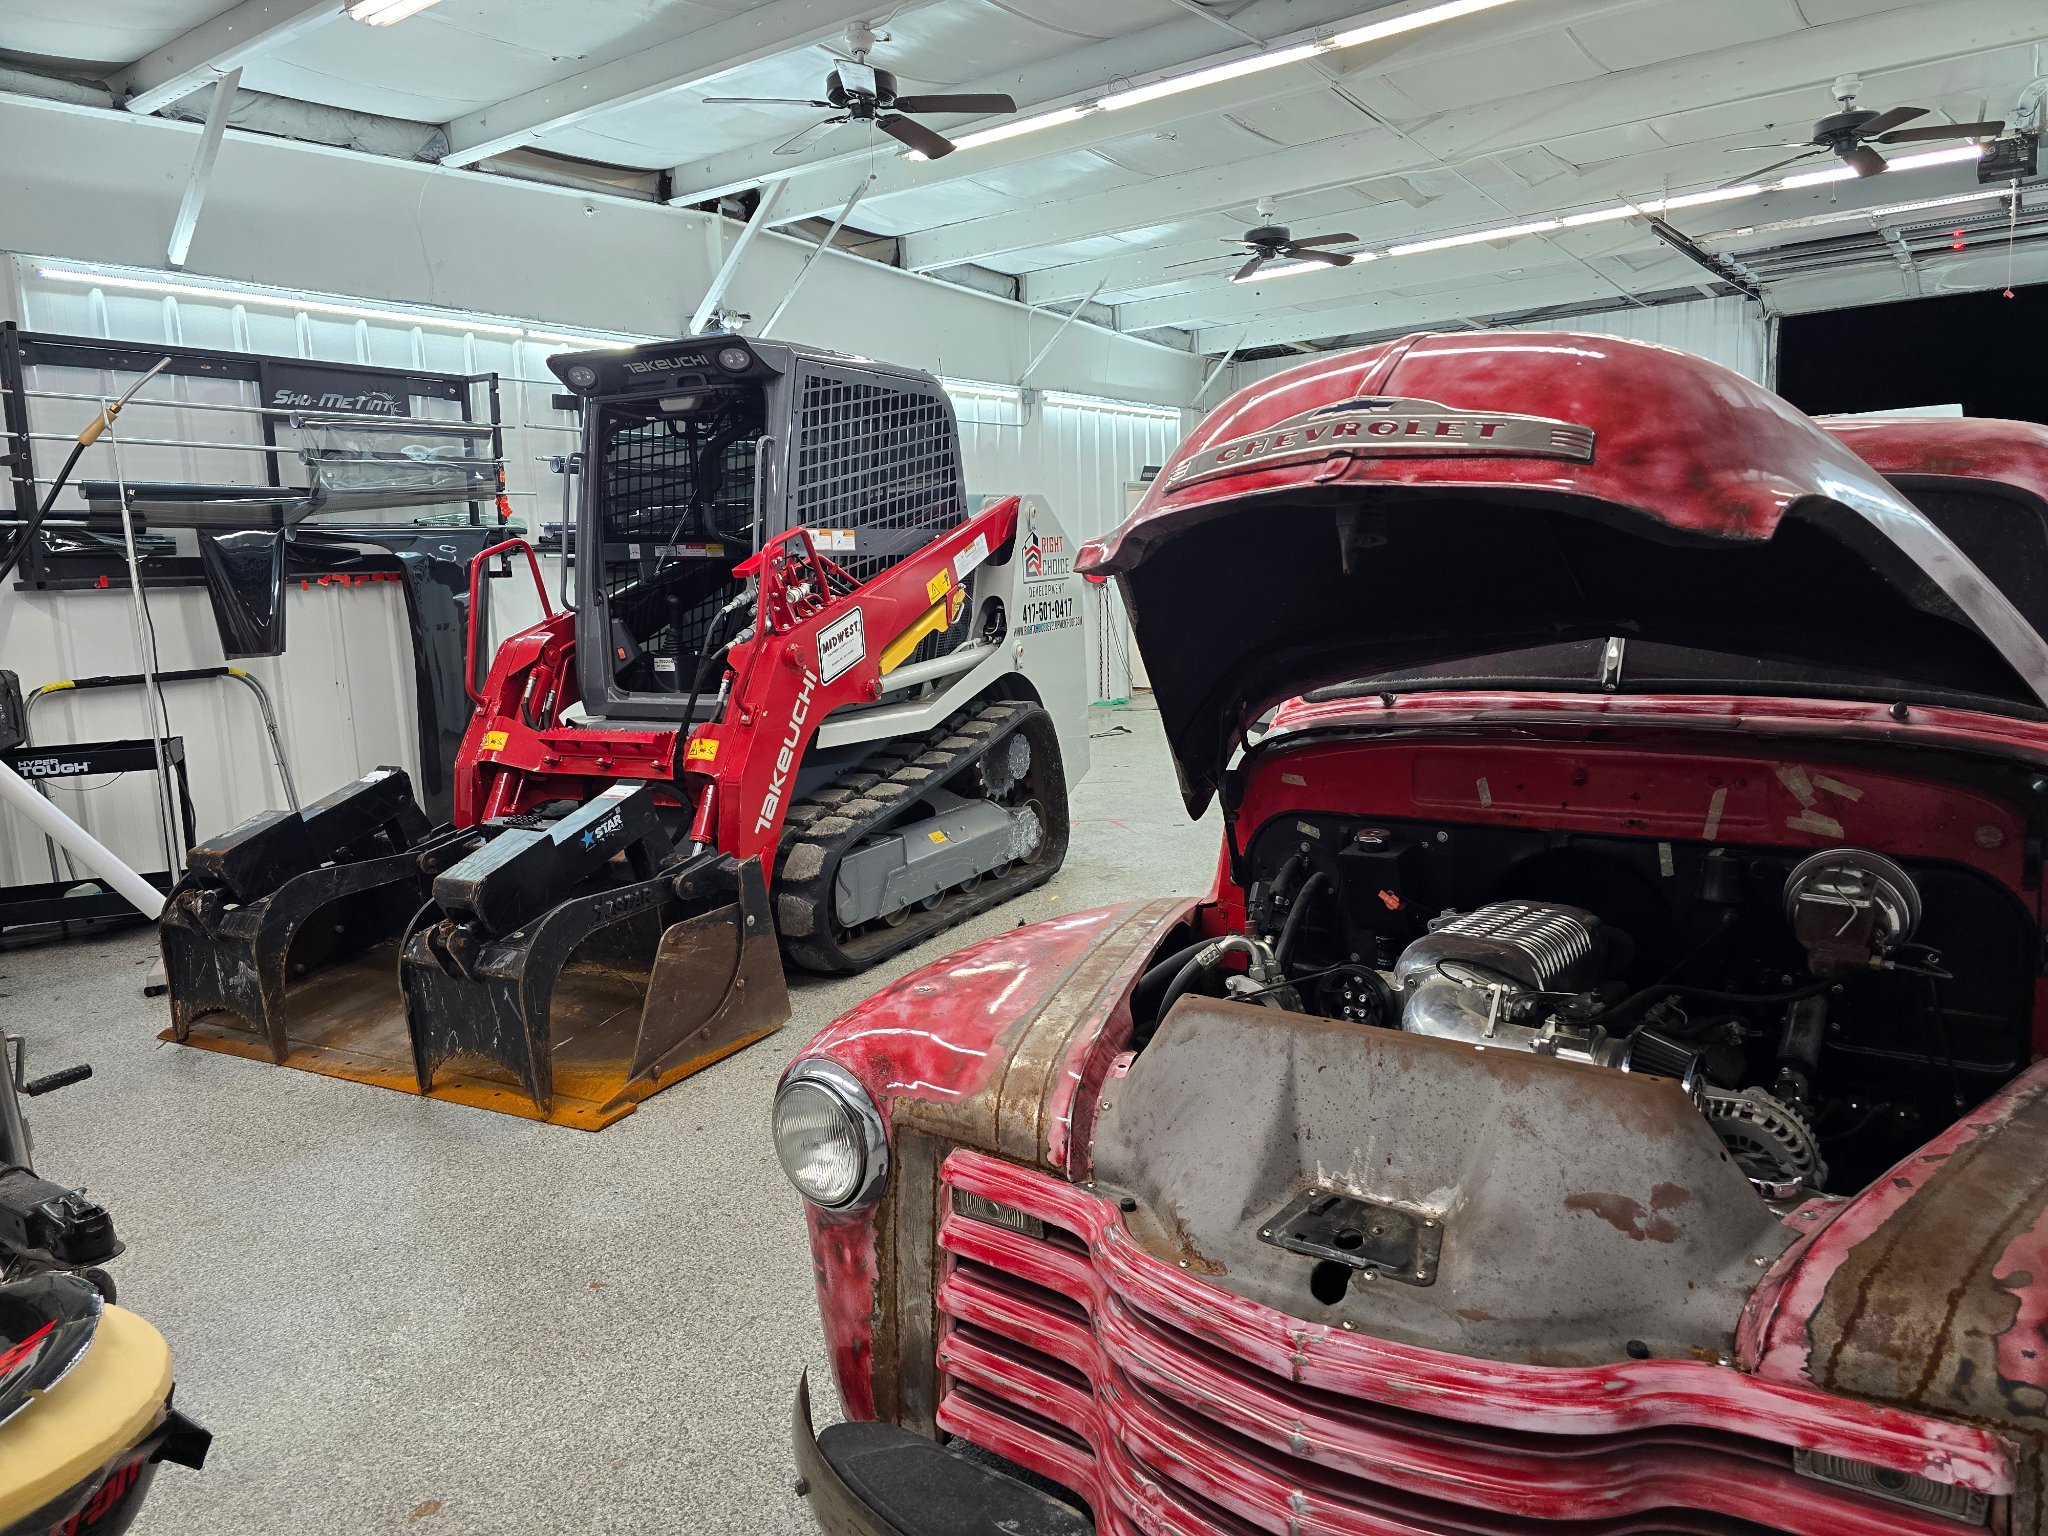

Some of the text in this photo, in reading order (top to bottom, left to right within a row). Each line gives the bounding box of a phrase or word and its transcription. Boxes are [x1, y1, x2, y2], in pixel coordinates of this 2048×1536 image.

[622, 354, 710, 374] TAKEUCHI
[1216, 420, 1507, 463] CHEVROLET
[1041, 536, 1064, 554] RIGHT
[1043, 557, 1069, 576] CHOICE
[1028, 583, 1065, 598] DEVELOPMENT
[1022, 598, 1073, 624] 417-501-0417
[822, 620, 859, 654] MIDWEST
[754, 669, 818, 835] TAKEUCHI
[18, 758, 59, 768] HYPER
[18, 761, 89, 777] TOUGH
[595, 814, 622, 839] STAR
